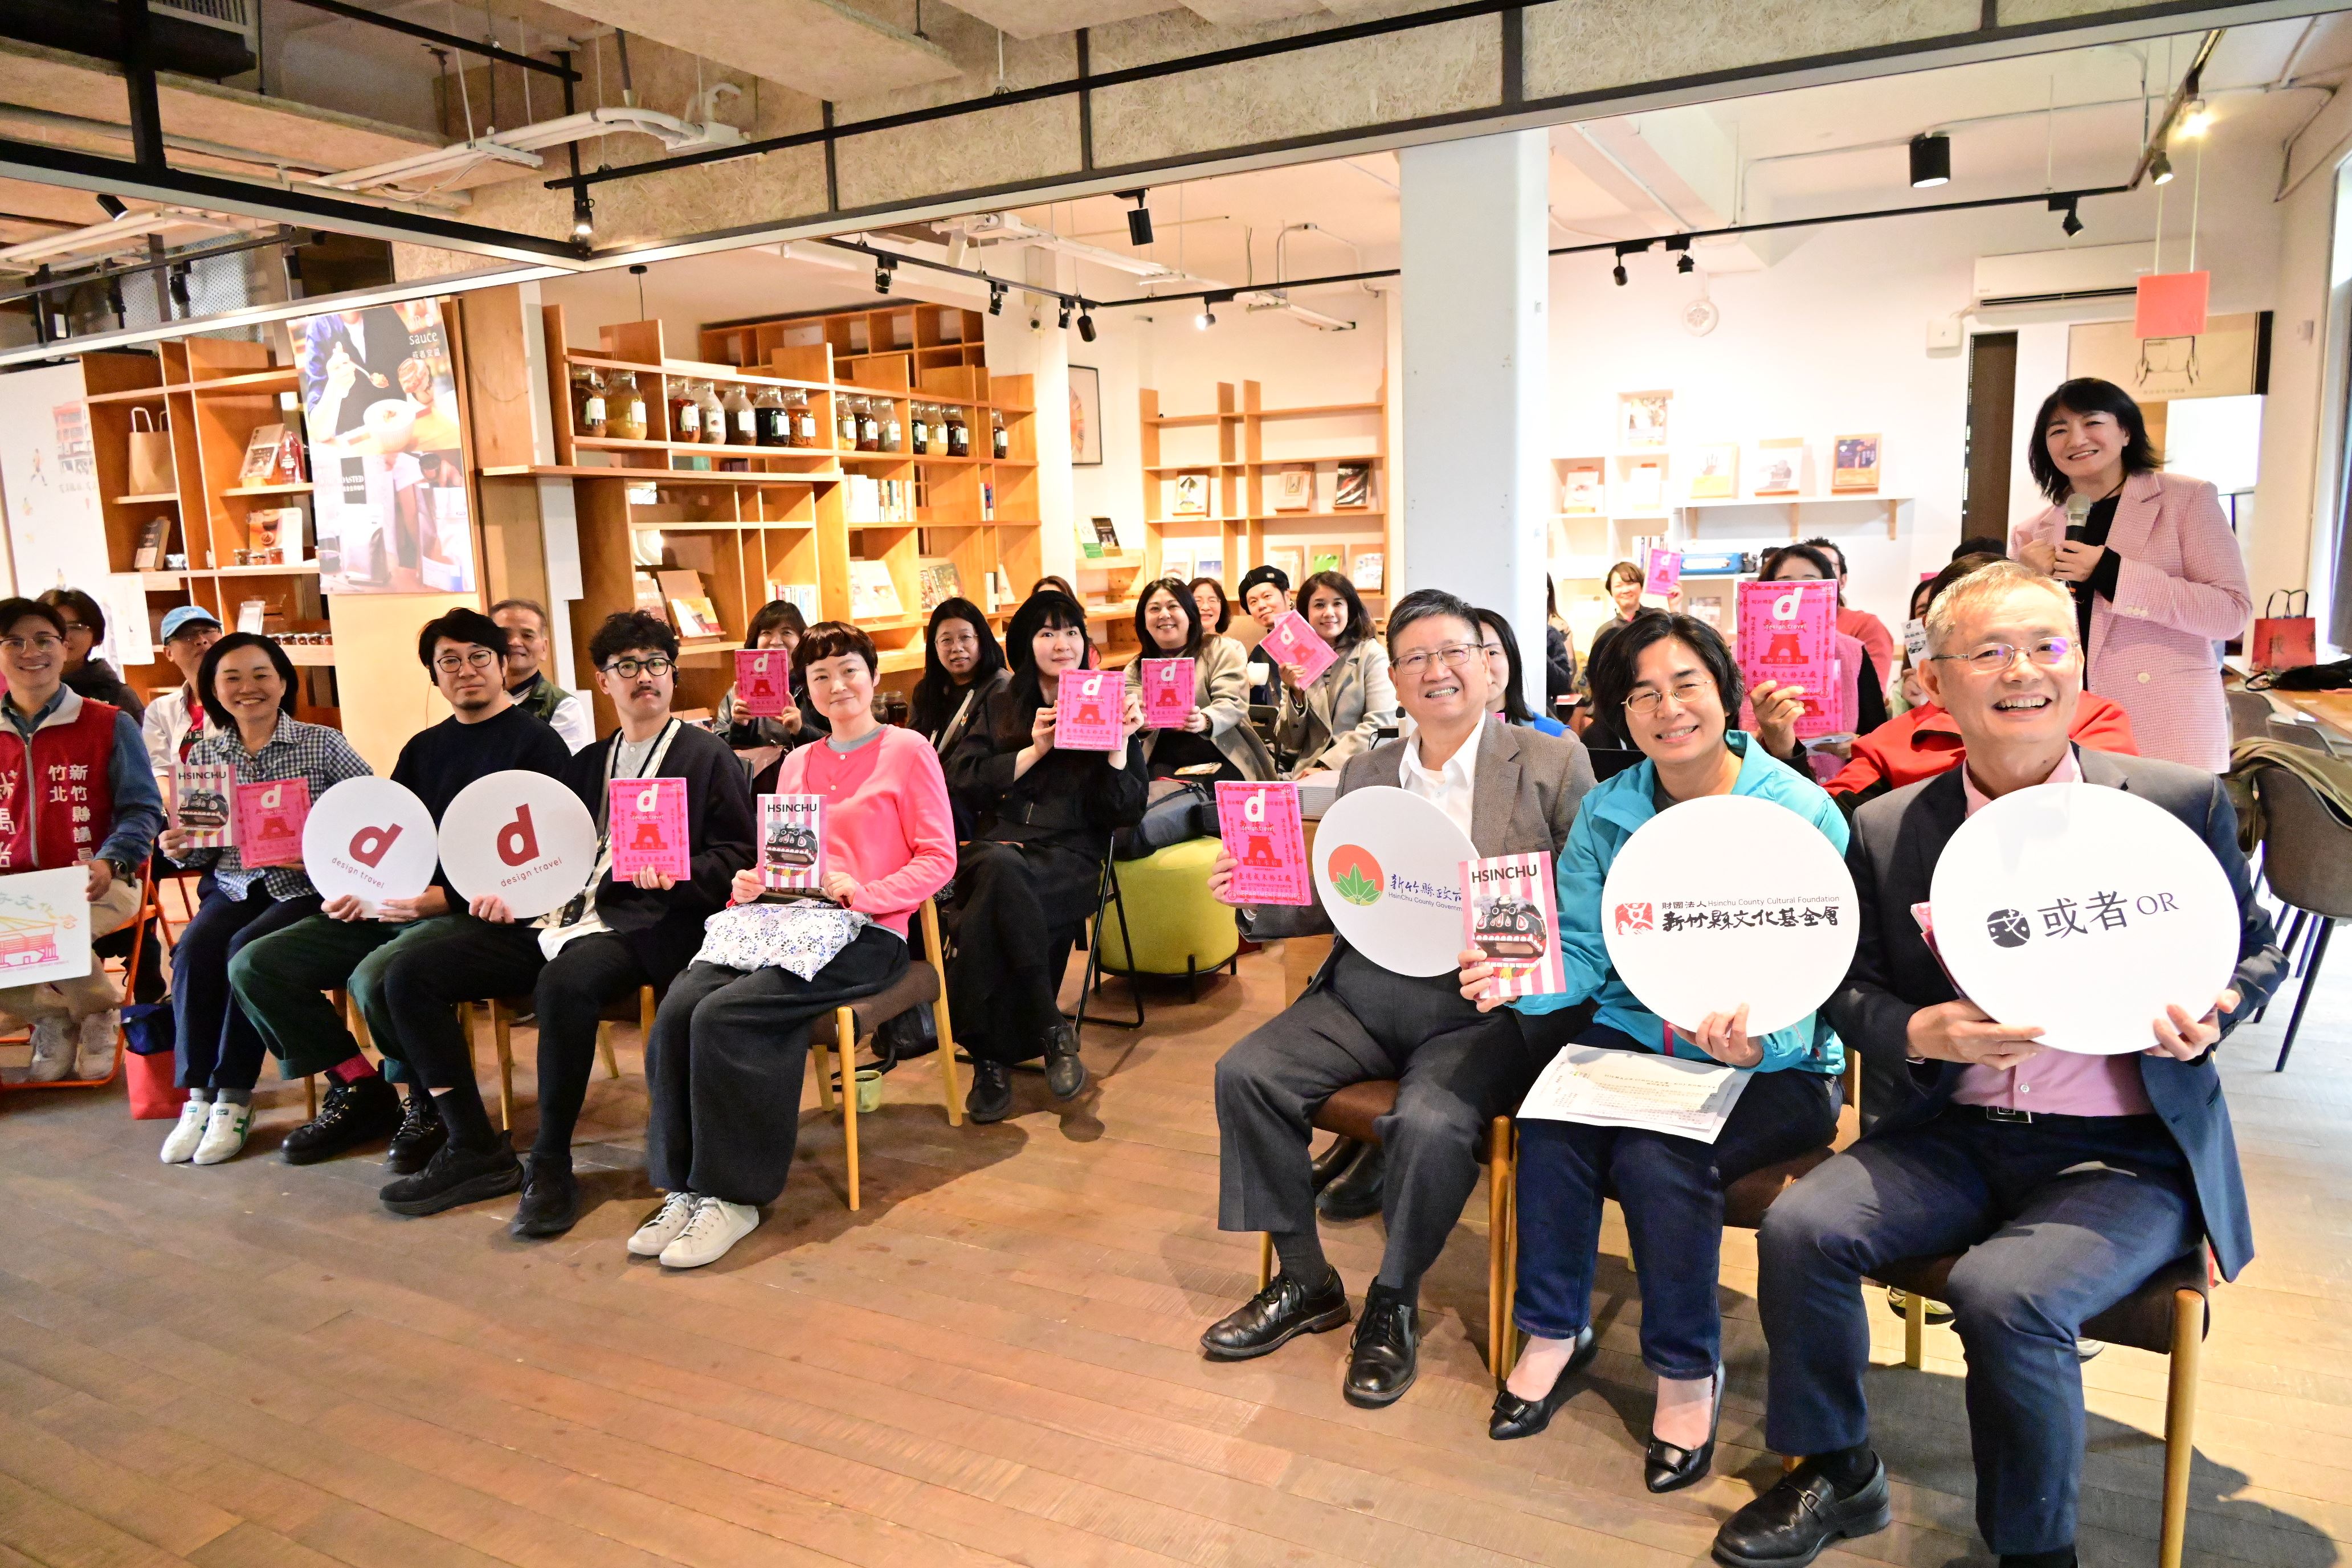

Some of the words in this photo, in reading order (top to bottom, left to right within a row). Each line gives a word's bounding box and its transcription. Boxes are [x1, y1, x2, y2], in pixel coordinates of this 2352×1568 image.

[409, 332, 438, 345] sauce
[1772, 587, 1804, 620] d
[1281, 623, 1295, 645] d
[754, 653, 769, 672] d
[1161, 662, 1177, 681] d
[1082, 675, 1103, 696] d
[48, 764, 68, 802] 竹北
[260, 784, 281, 808] d
[636, 783, 659, 812] d
[767, 804, 817, 812] HSINCHU
[1244, 789, 1265, 822] d
[349, 823, 403, 868] d
[497, 803, 540, 867] d
[332, 858, 358, 875] design
[360, 871, 385, 888] travel
[501, 871, 532, 887] design
[534, 857, 562, 873] travel
[1472, 864, 1537, 883] HSINCHU
[1389, 892, 1412, 902] HsinChu
[1414, 897, 1434, 907] County
[1661, 900, 1707, 909] 財團法人
[1738, 899, 1764, 907] County
[1662, 906, 1839, 932] 新竹縣文化基金會
[2037, 891, 2128, 939] 或者
[2137, 892, 2179, 914] OR
